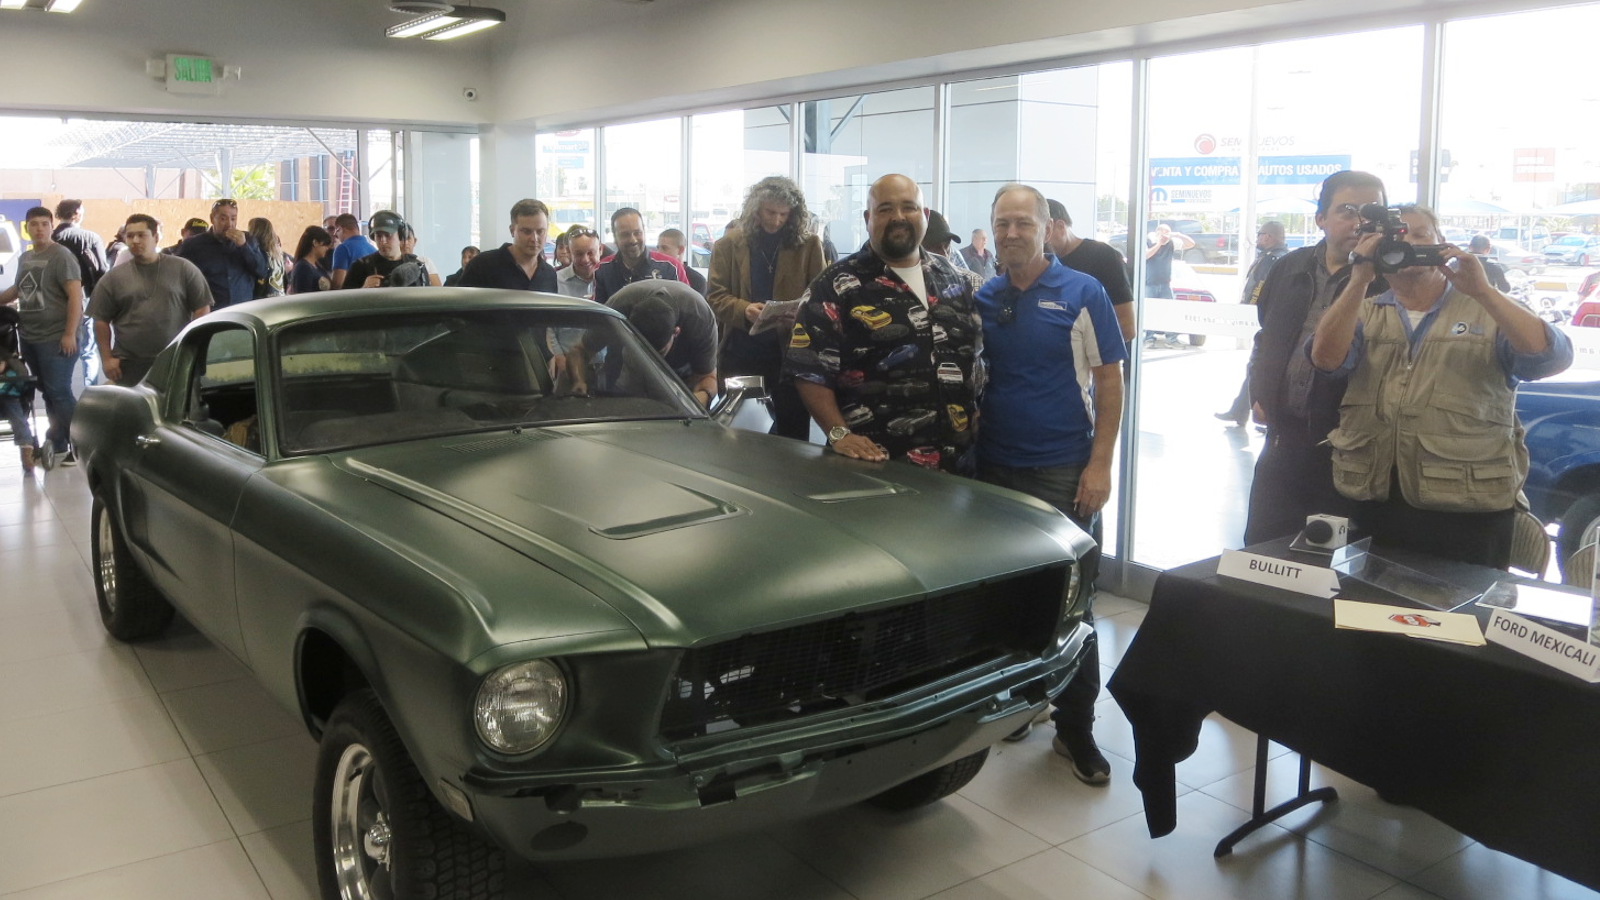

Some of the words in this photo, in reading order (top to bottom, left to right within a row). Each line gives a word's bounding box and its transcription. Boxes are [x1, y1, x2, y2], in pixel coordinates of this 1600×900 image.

[174, 58, 212, 82] SALIDA
[1184, 166, 1193, 177] Y
[1194, 165, 1239, 177] COMPRA
[1258, 164, 1294, 176] AUTOS
[1296, 164, 1342, 176] USADOS
[1170, 189, 1212, 199] SEMINUEVOS
[1249, 559, 1303, 580] BULLITT
[1493, 615, 1529, 638] FORD
[1529, 630, 1597, 667] MEXICALI
